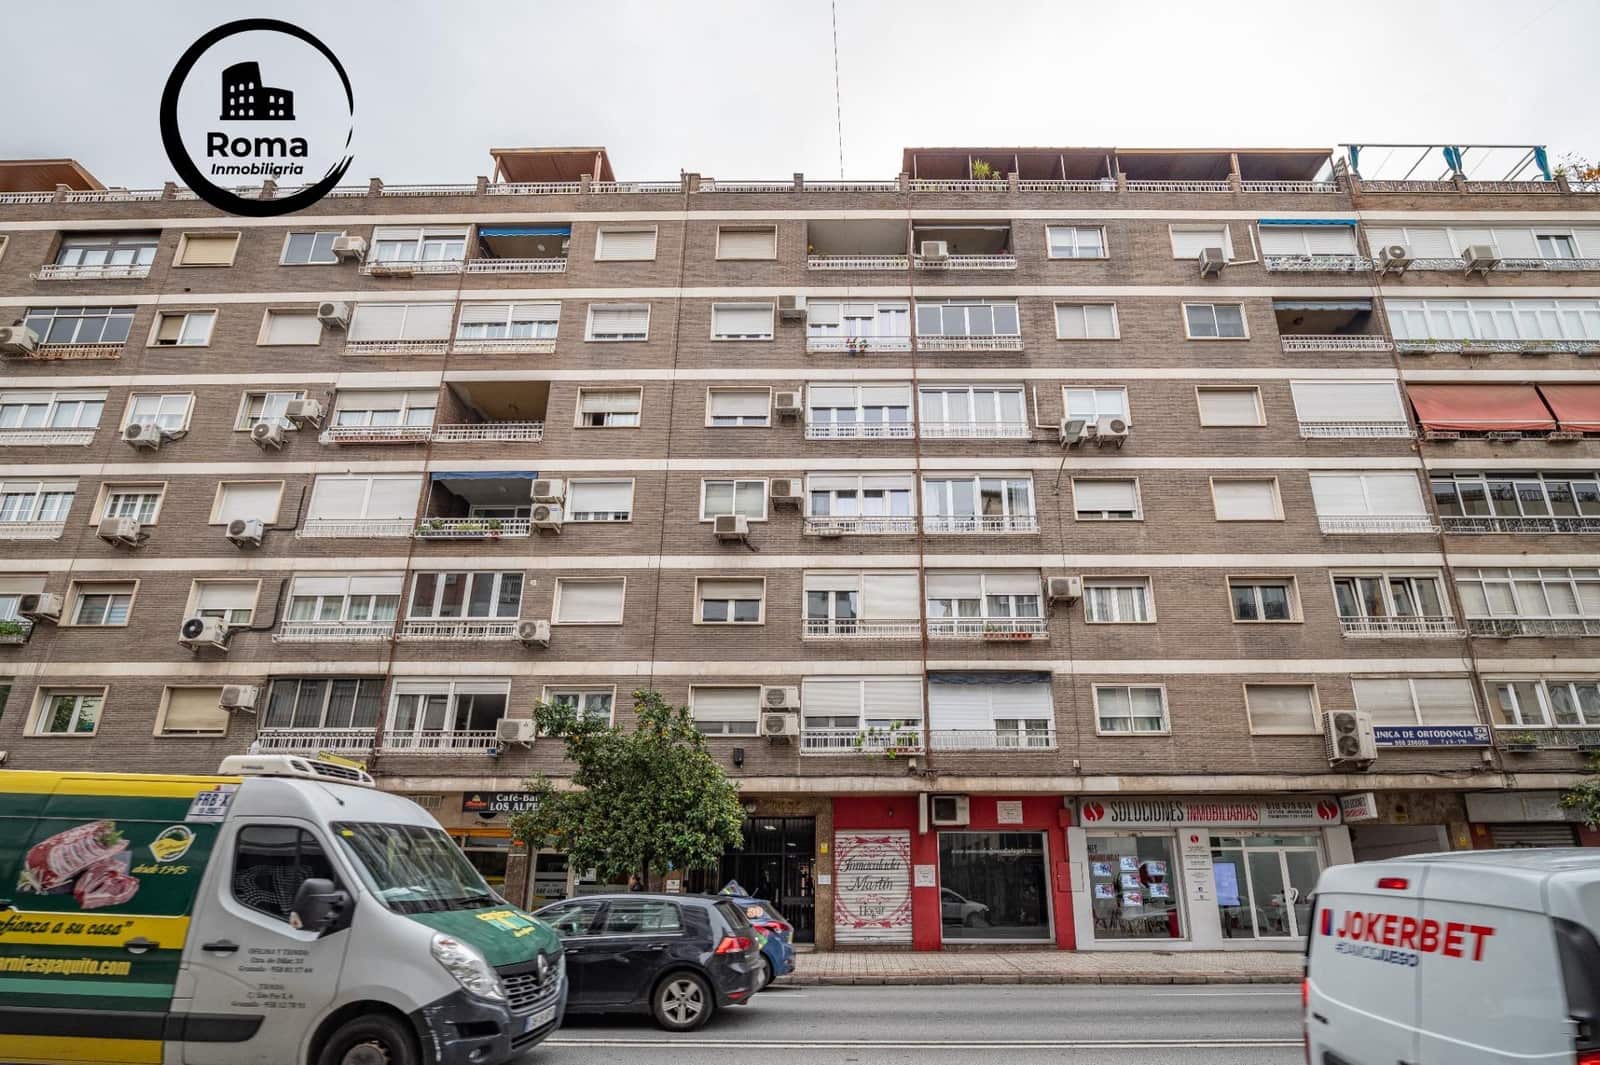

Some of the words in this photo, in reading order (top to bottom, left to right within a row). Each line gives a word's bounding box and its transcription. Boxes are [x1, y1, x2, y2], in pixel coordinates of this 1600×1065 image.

[1403, 730, 1415, 739] DE
[1417, 729, 1474, 739] ORTODONCIA
[489, 802, 509, 811] LOS
[1110, 800, 1184, 822] SOLUCIONES
[1186, 801, 1258, 822] INMOBILIARIAS
[51, 922, 64, 934] a
[64, 922, 86, 934] su
[1336, 910, 1497, 962] JOKERBET
